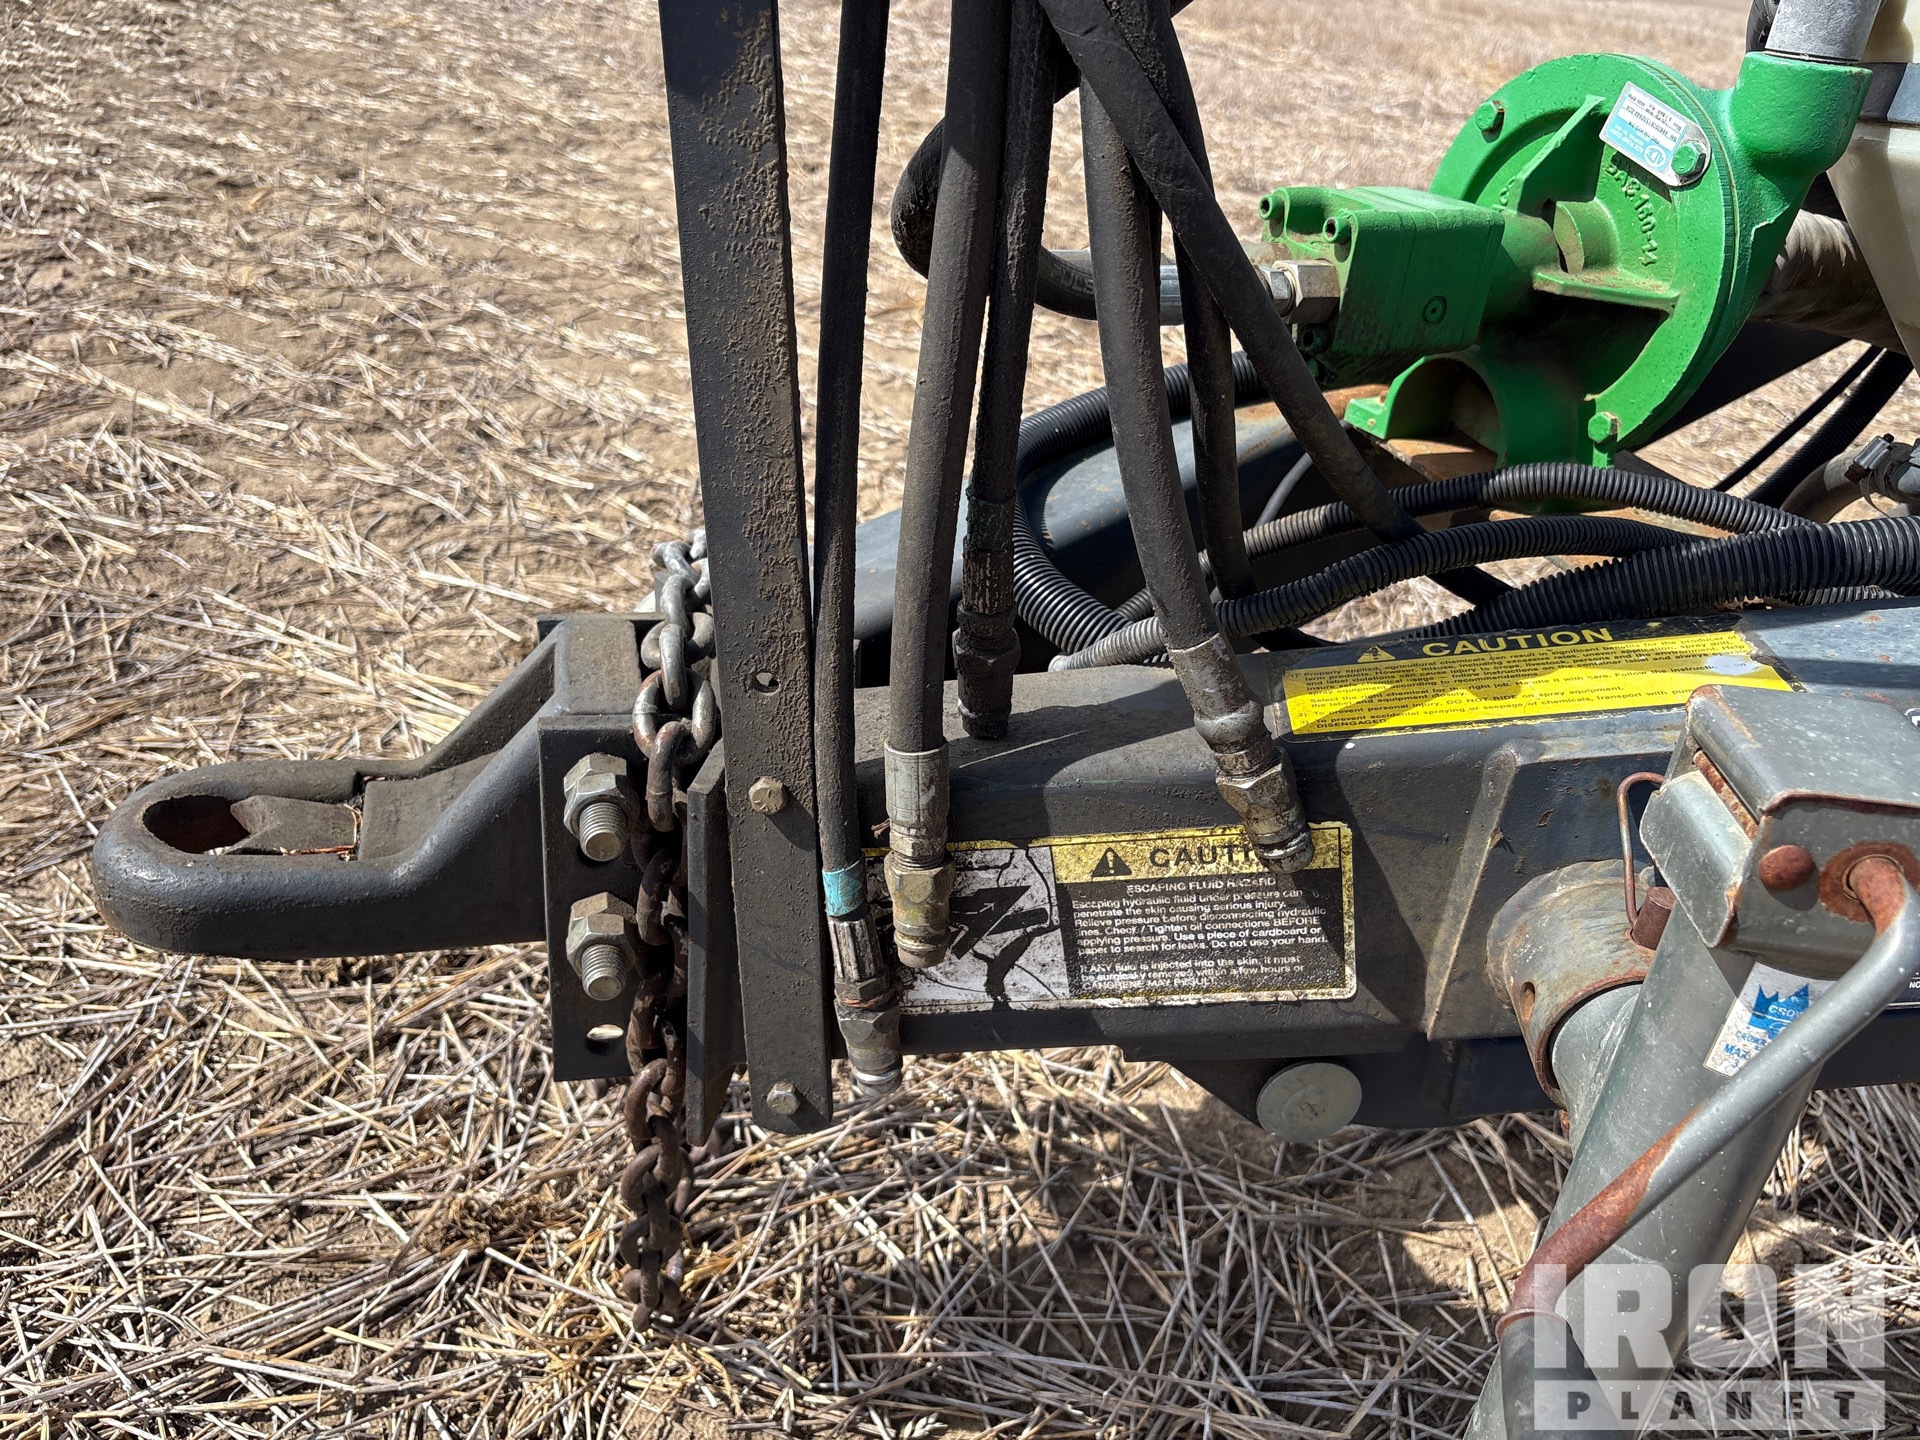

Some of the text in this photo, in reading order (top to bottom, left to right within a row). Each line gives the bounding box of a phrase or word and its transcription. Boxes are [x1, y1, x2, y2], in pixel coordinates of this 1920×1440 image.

[1422, 628, 1613, 657] CAUTION
[1304, 670, 1342, 678] Properly
[1345, 666, 1382, 674] applied,
[1384, 662, 1437, 671] agricultural
[1439, 657, 1486, 665] chemicals
[1550, 647, 1600, 656] significant
[1679, 636, 1725, 645] producer
[1458, 660, 1503, 668] including
[1505, 656, 1550, 664] excessive
[1483, 667, 1539, 676] instructions
[1673, 652, 1709, 660] always
[1336, 685, 1387, 694] equipment
[1390, 681, 1437, 689] according
[1352, 674, 1396, 682] violations
[1377, 694, 1428, 703] equipment
[1386, 689, 1429, 697] chemical
[1329, 707, 1364, 715] prevent
[1367, 704, 1409, 712] personal
[1331, 715, 1366, 723] prevent
[1370, 711, 1419, 719] accidental
[1423, 707, 1466, 715] spraying
[1483, 703, 1525, 711] seepage
[1596, 692, 1643, 701] transport
[1149, 843, 1253, 868] CAUTI
[1126, 877, 1276, 893] ESCAPING FLUID HAZARD
[1072, 898, 1120, 910] Escaping
[1122, 896, 1171, 908] hydraulic
[1173, 895, 1196, 903] fluid
[1199, 893, 1229, 902] under
[1233, 891, 1280, 902] pressure
[1073, 899, 1286, 919] penetrate the skin causing serious injury.
[1074, 907, 1326, 927] Relieve pressure before disconnecting hydraulic
[1148, 923, 1187, 934] Tighten
[1205, 919, 1270, 930] connections
[1273, 916, 1320, 926] BEFORE
[1076, 937, 1121, 947] applying
[1123, 935, 1171, 945] pressure.
[1174, 932, 1195, 941] Use
[1206, 931, 1237, 941] piece
[1240, 929, 1250, 937] of
[1252, 926, 1307, 937] cardboard
[1078, 948, 1107, 956] paper
[1123, 944, 1159, 952] search
[1161, 943, 1176, 951] for
[1178, 941, 1208, 950] leaks.
[1211, 940, 1227, 948] Do
[1271, 938, 1295, 947] your
[1298, 935, 1327, 944] hand.
[1089, 964, 1112, 972] ANY
[1151, 960, 1192, 970] injected
[1194, 959, 1214, 967] into
[1217, 958, 1234, 966] the
[1273, 956, 1300, 964] must
